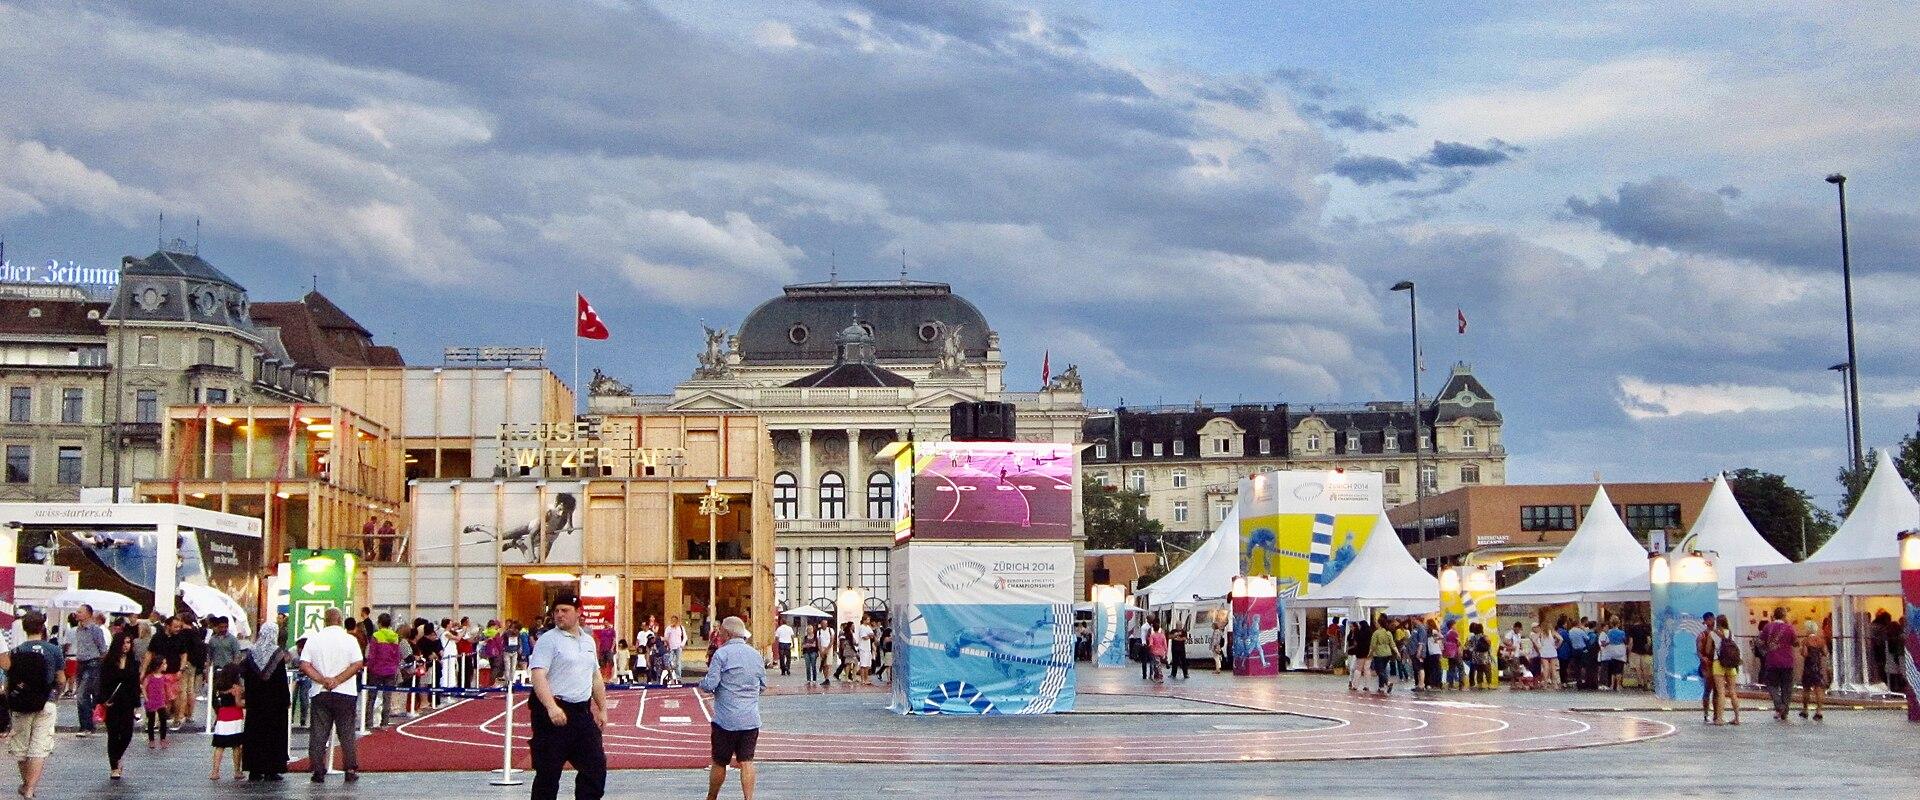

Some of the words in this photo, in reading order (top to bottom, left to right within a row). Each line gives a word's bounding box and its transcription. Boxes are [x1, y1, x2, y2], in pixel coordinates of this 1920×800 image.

[40, 259, 120, 290] Zeitung
[34, 507, 113, 518] swiss-starters.ch
[993, 561, 1030, 572] ZÜRICH
[1032, 562, 1055, 572] 2014
